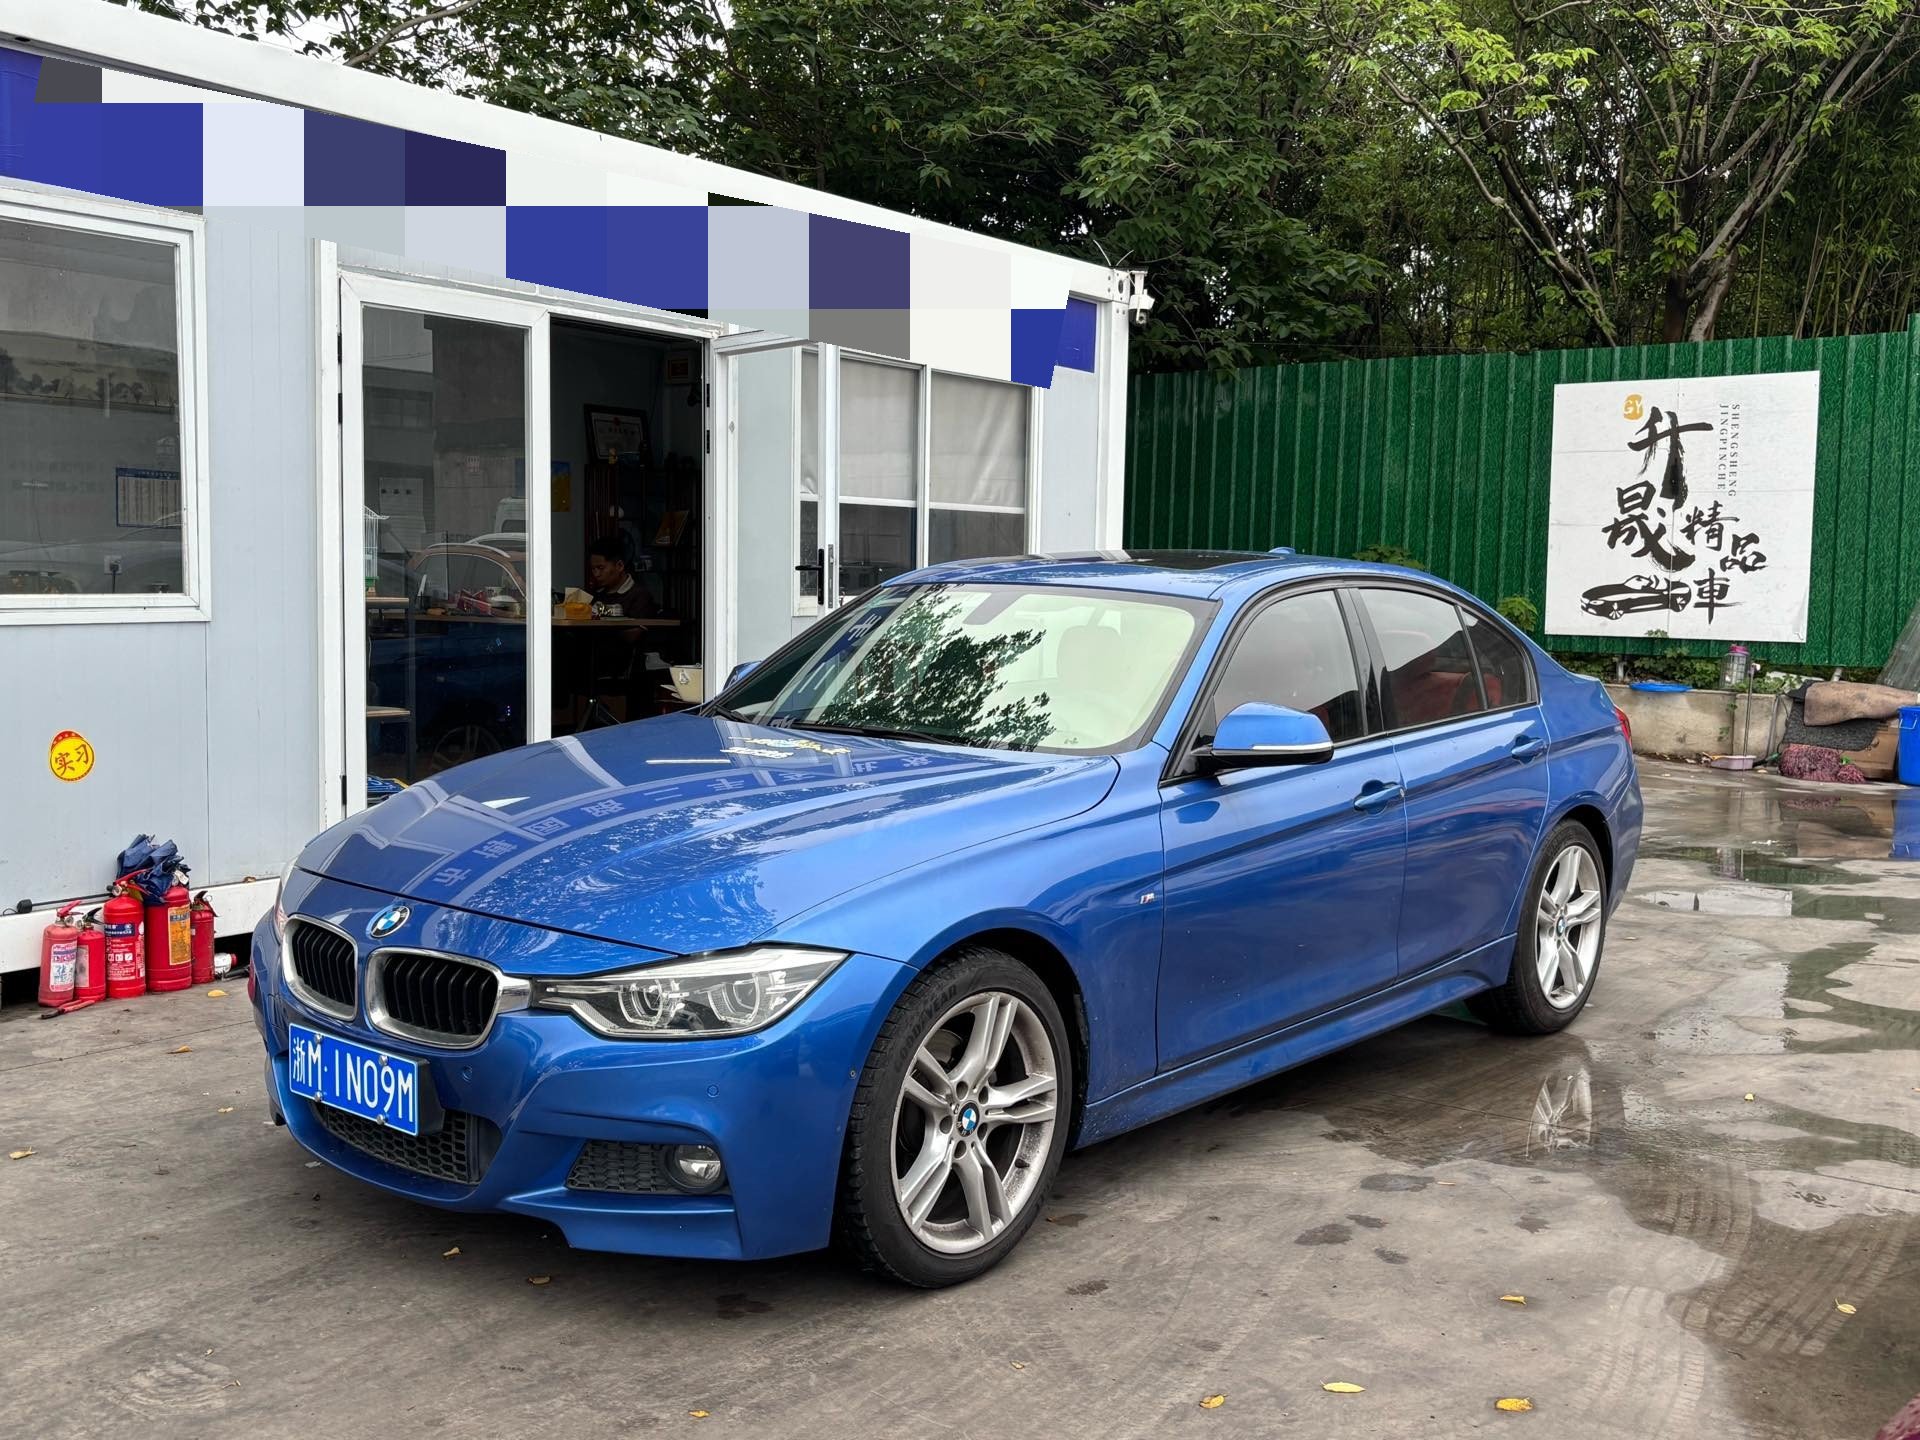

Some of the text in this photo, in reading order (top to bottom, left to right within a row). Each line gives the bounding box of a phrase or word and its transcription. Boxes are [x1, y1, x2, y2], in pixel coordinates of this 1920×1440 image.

[1717, 404, 1730, 490] JINGPINCHE
[1728, 403, 1741, 497] SHENGSHENG
[55, 744, 89, 776] 实习
